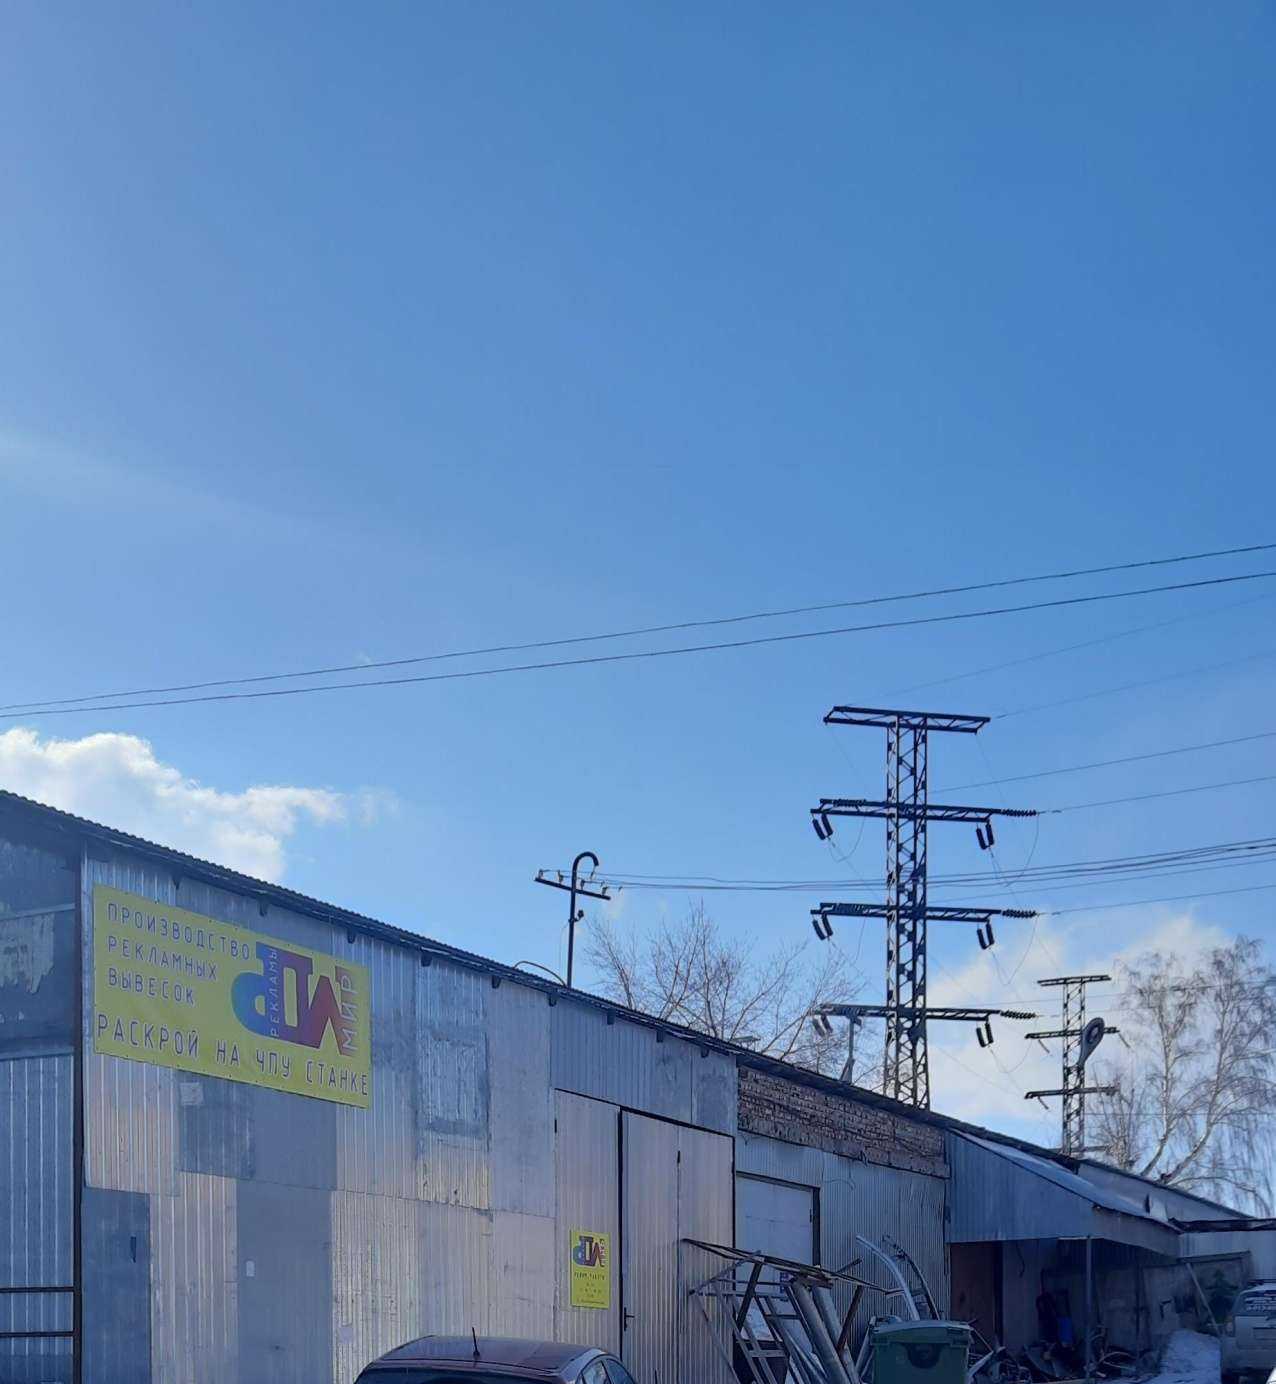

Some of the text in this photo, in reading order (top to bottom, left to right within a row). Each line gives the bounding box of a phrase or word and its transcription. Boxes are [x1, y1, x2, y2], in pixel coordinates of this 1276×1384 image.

[108, 903, 250, 960] ПРОИЗВОДСТВО
[108, 935, 217, 981] РЕКЛАМНЫХ
[108, 967, 194, 1005] ВЫВЕСОК
[269, 949, 280, 1037] РЕКЛАМЫ
[340, 974, 358, 1052] МИР
[97, 1014, 368, 1096] РАСКРОЙ НА ЧПУ СТАНКЕ
